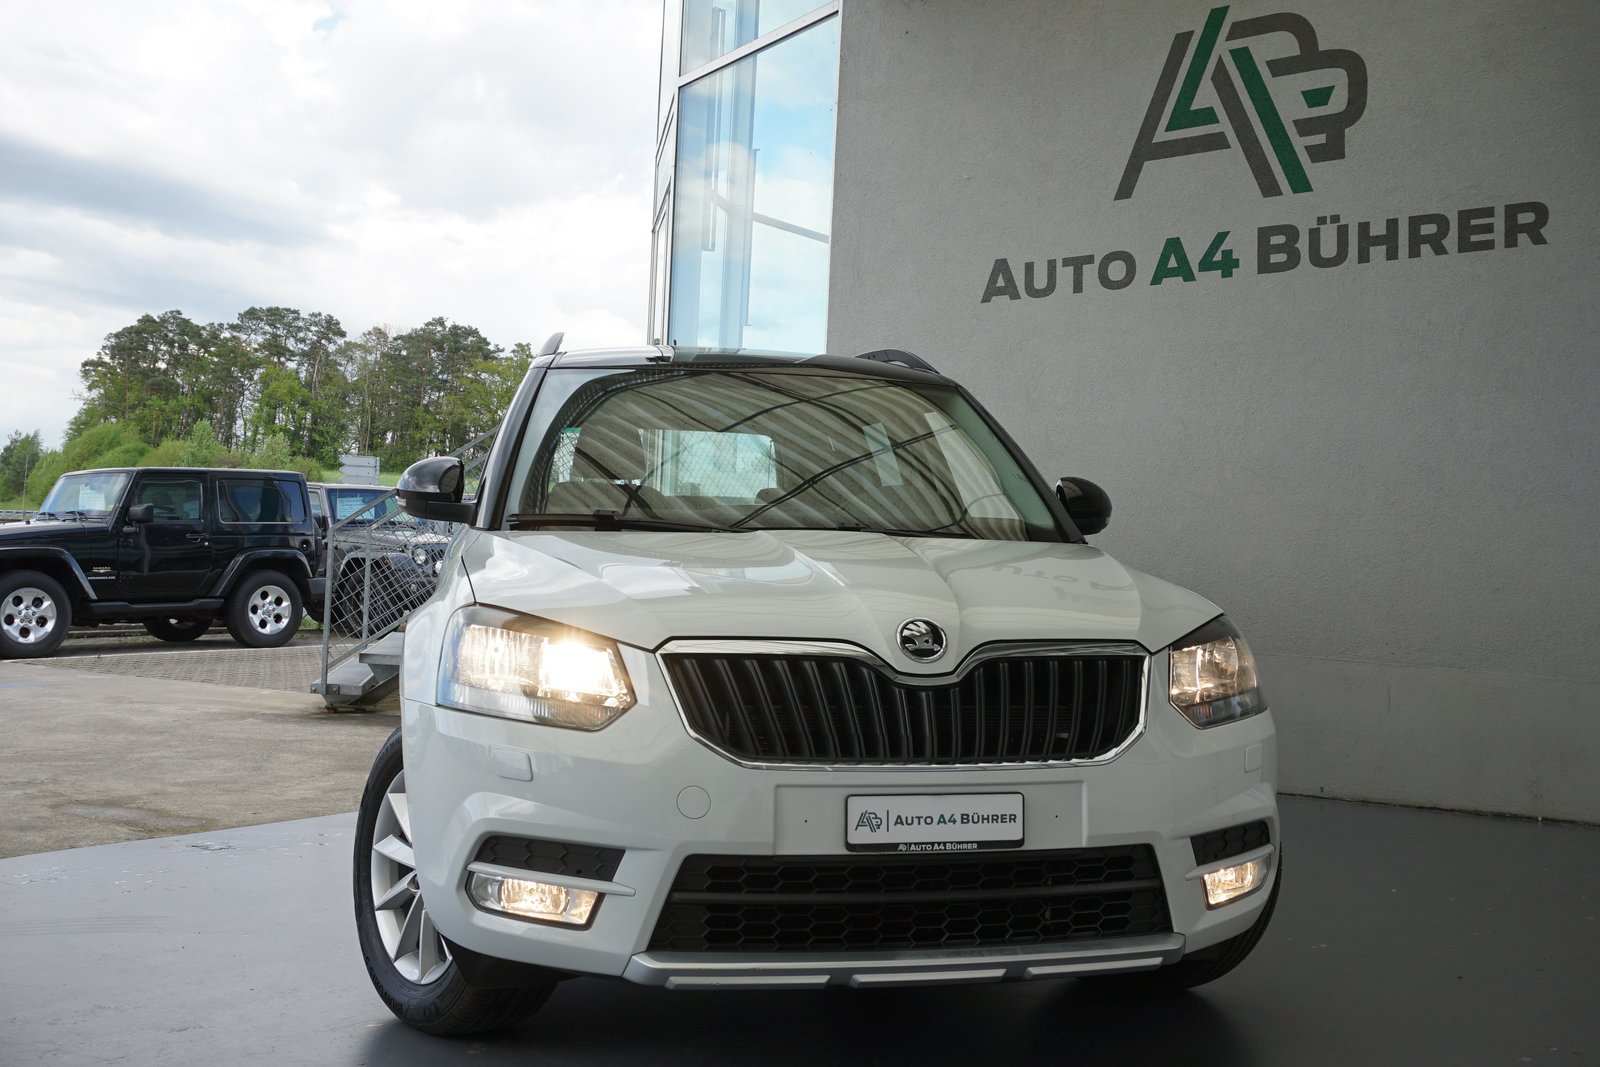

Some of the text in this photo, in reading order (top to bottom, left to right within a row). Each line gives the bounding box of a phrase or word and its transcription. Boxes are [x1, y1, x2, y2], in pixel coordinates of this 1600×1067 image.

[980, 201, 1550, 303] AUTO A4 BÜHRER
[893, 812, 1018, 827] AUTO A4 BÜHRER
[909, 843, 933, 852] AUTO
[933, 842, 945, 851] A4
